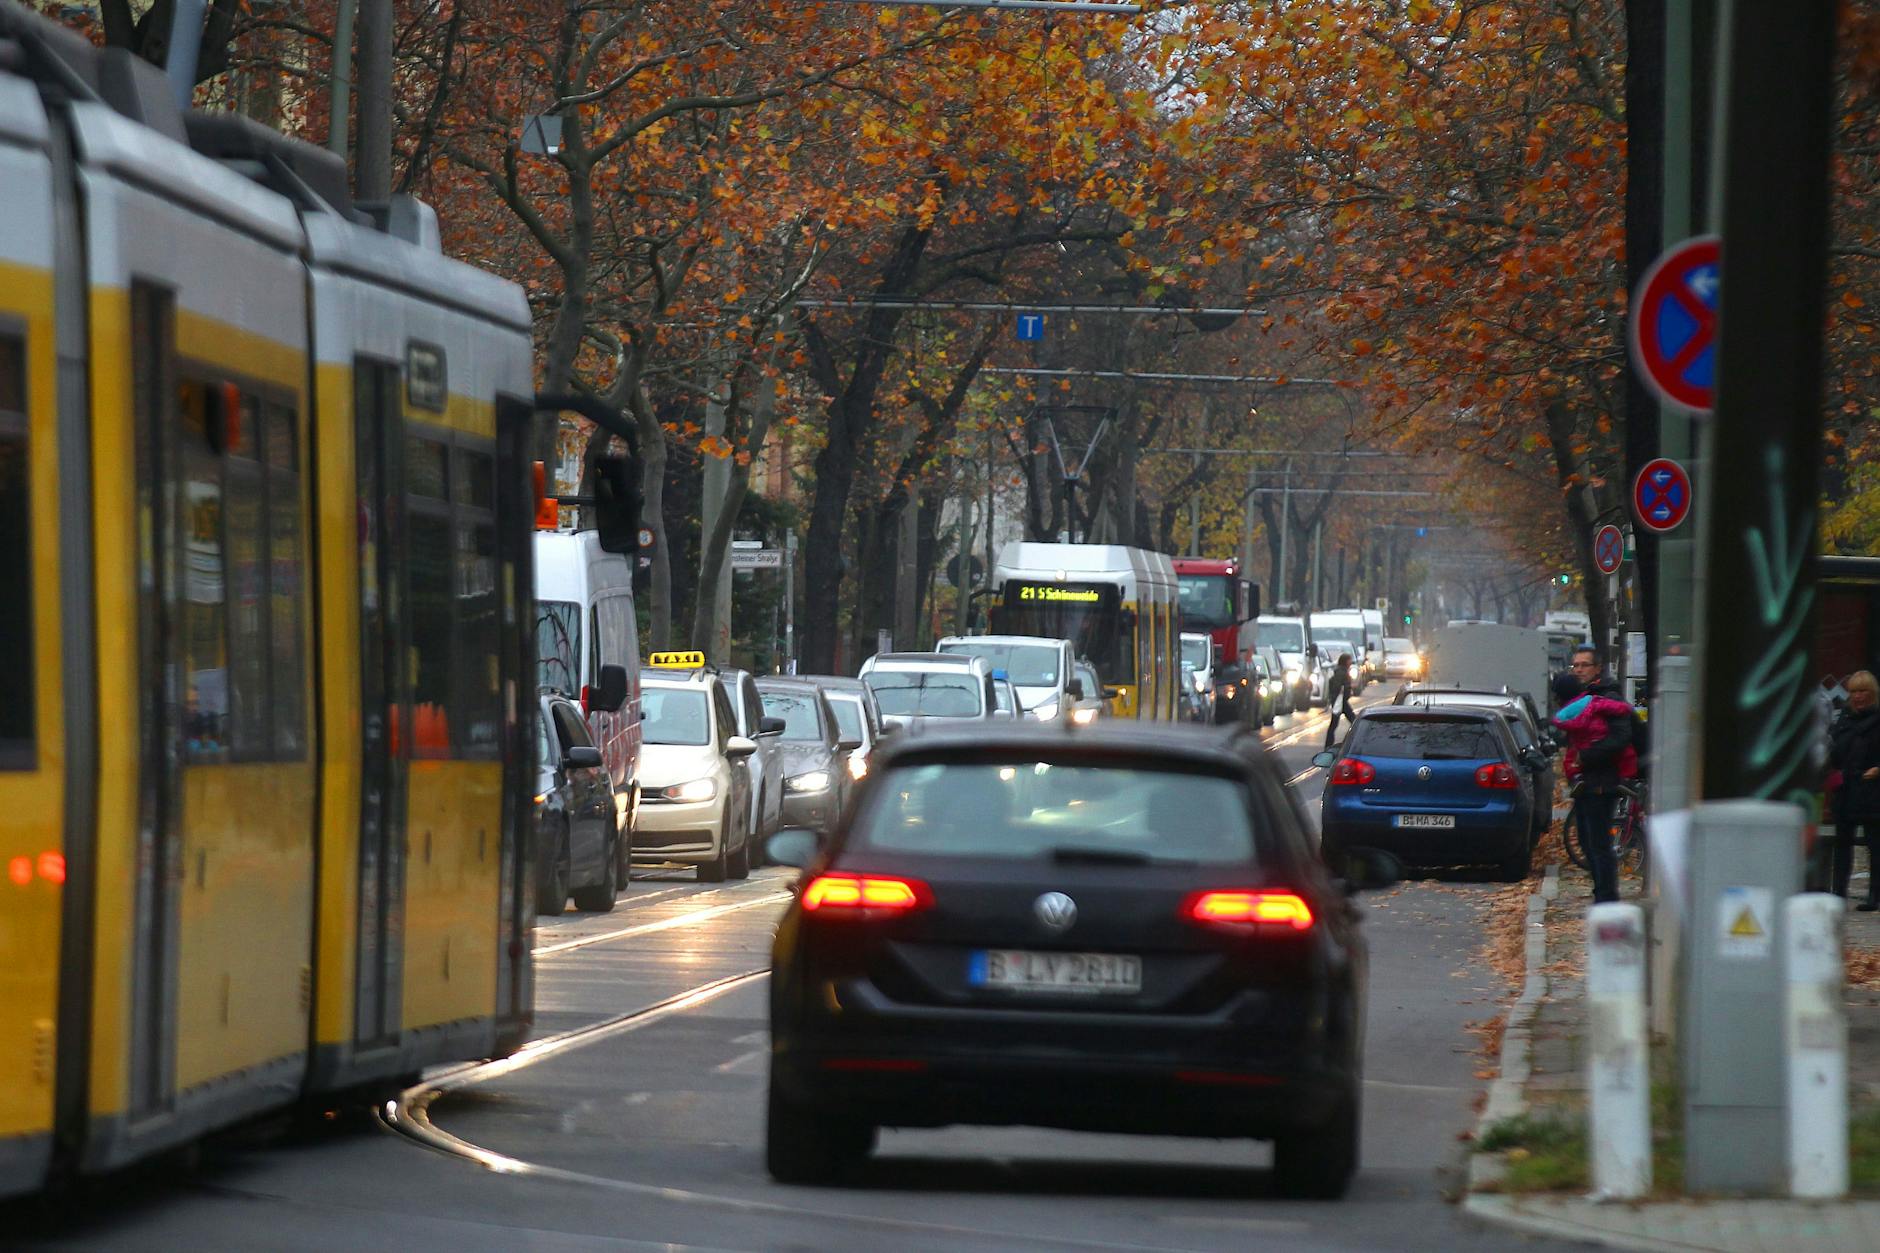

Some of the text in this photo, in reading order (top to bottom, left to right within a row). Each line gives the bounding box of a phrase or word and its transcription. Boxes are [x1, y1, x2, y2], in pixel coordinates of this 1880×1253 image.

[1023, 315, 1038, 337] T
[1021, 586, 1034, 599] 21
[655, 654, 698, 664] TAXI
[1403, 816, 1409, 825] B
[1432, 816, 1451, 826] 346
